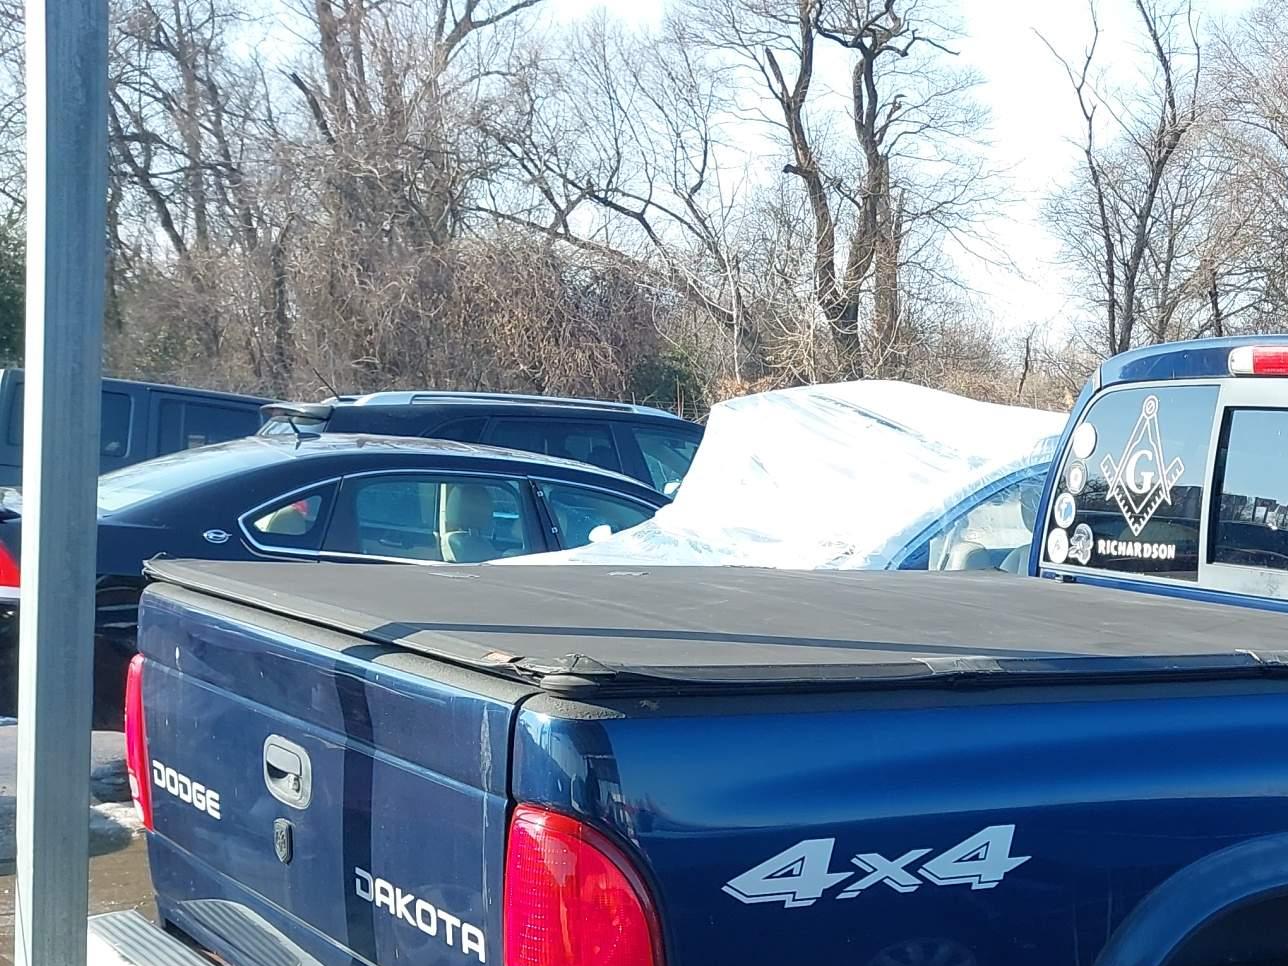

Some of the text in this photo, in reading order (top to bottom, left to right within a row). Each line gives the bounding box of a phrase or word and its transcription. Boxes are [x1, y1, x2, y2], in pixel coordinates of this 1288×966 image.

[1126, 450, 1154, 494] G
[1098, 540, 1176, 559] RICHARDSON
[152, 759, 221, 820] DODGE
[354, 866, 486, 963] DAKOTA
